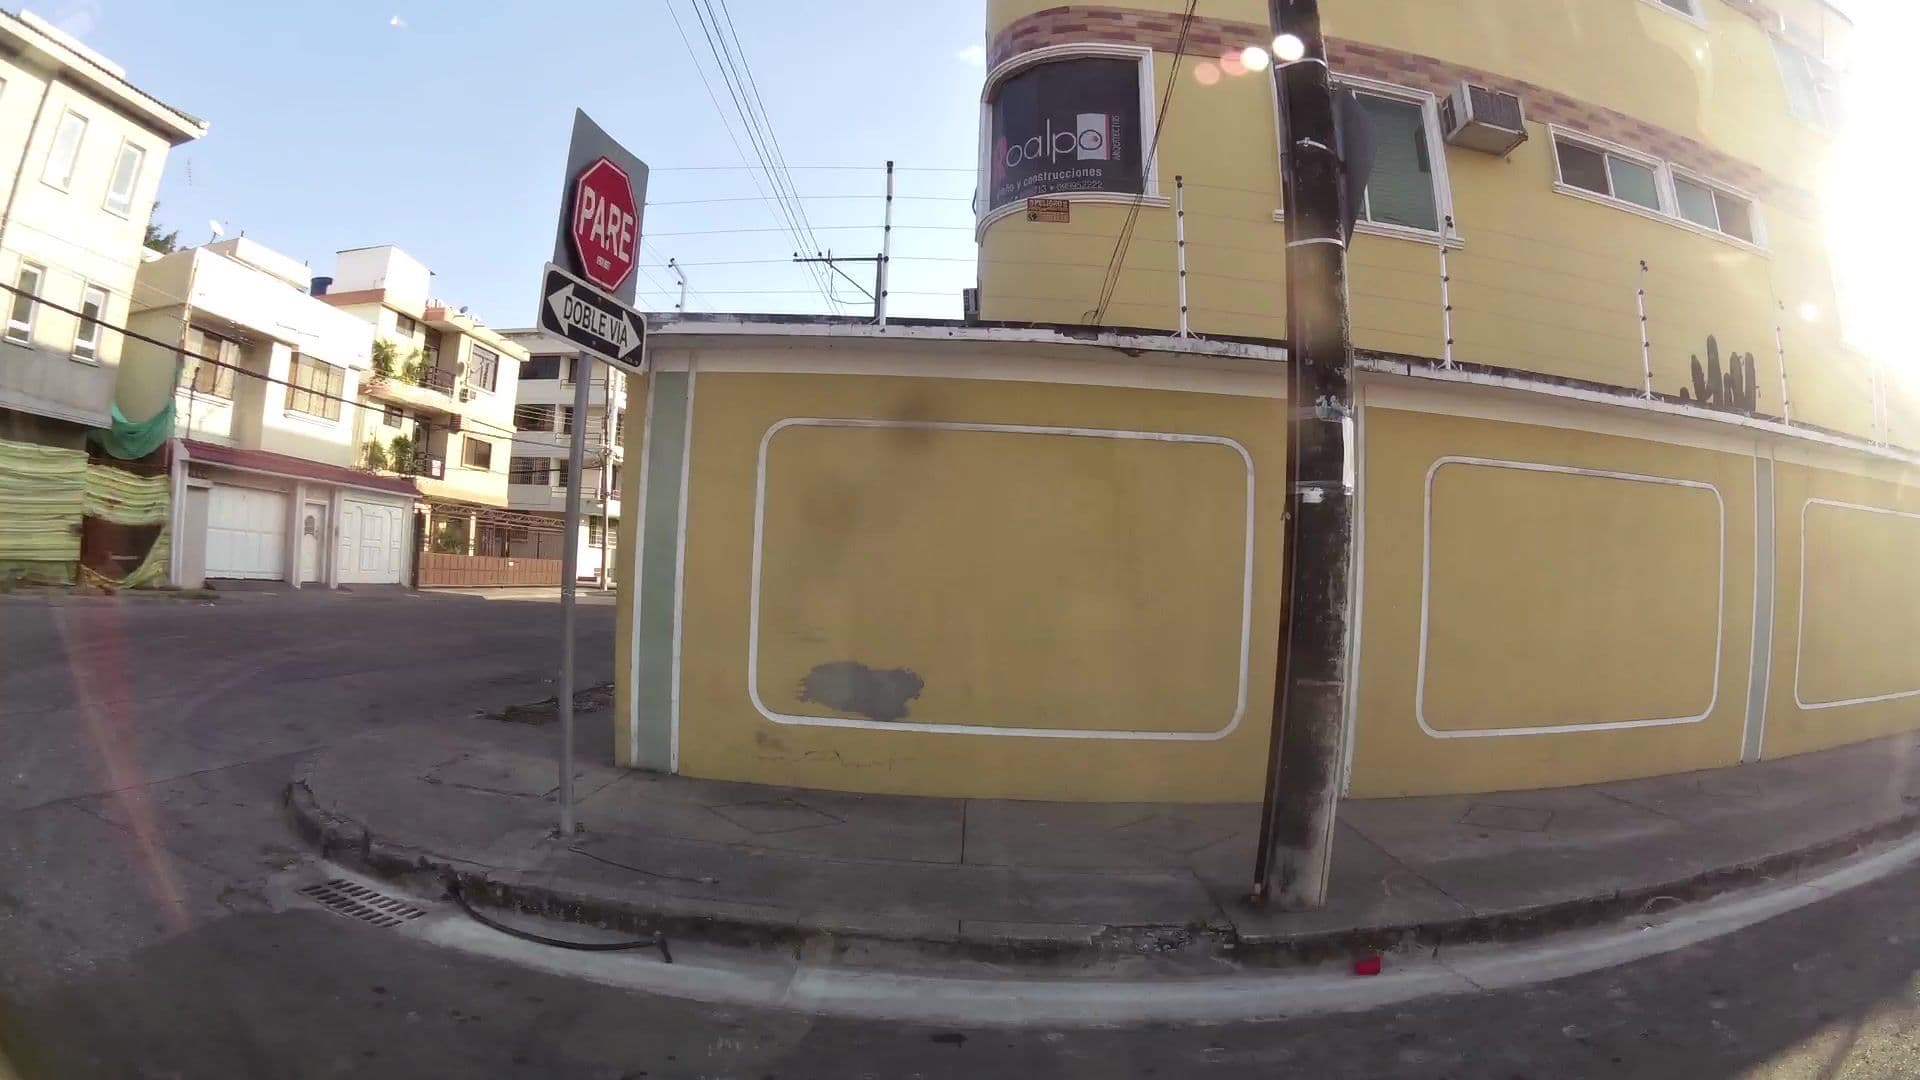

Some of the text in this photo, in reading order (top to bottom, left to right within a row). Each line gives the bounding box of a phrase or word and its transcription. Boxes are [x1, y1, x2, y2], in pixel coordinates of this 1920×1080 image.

[1023, 168, 1103, 187] construcciones
[578, 186, 633, 264] PARE
[563, 296, 607, 337] DOBLE
